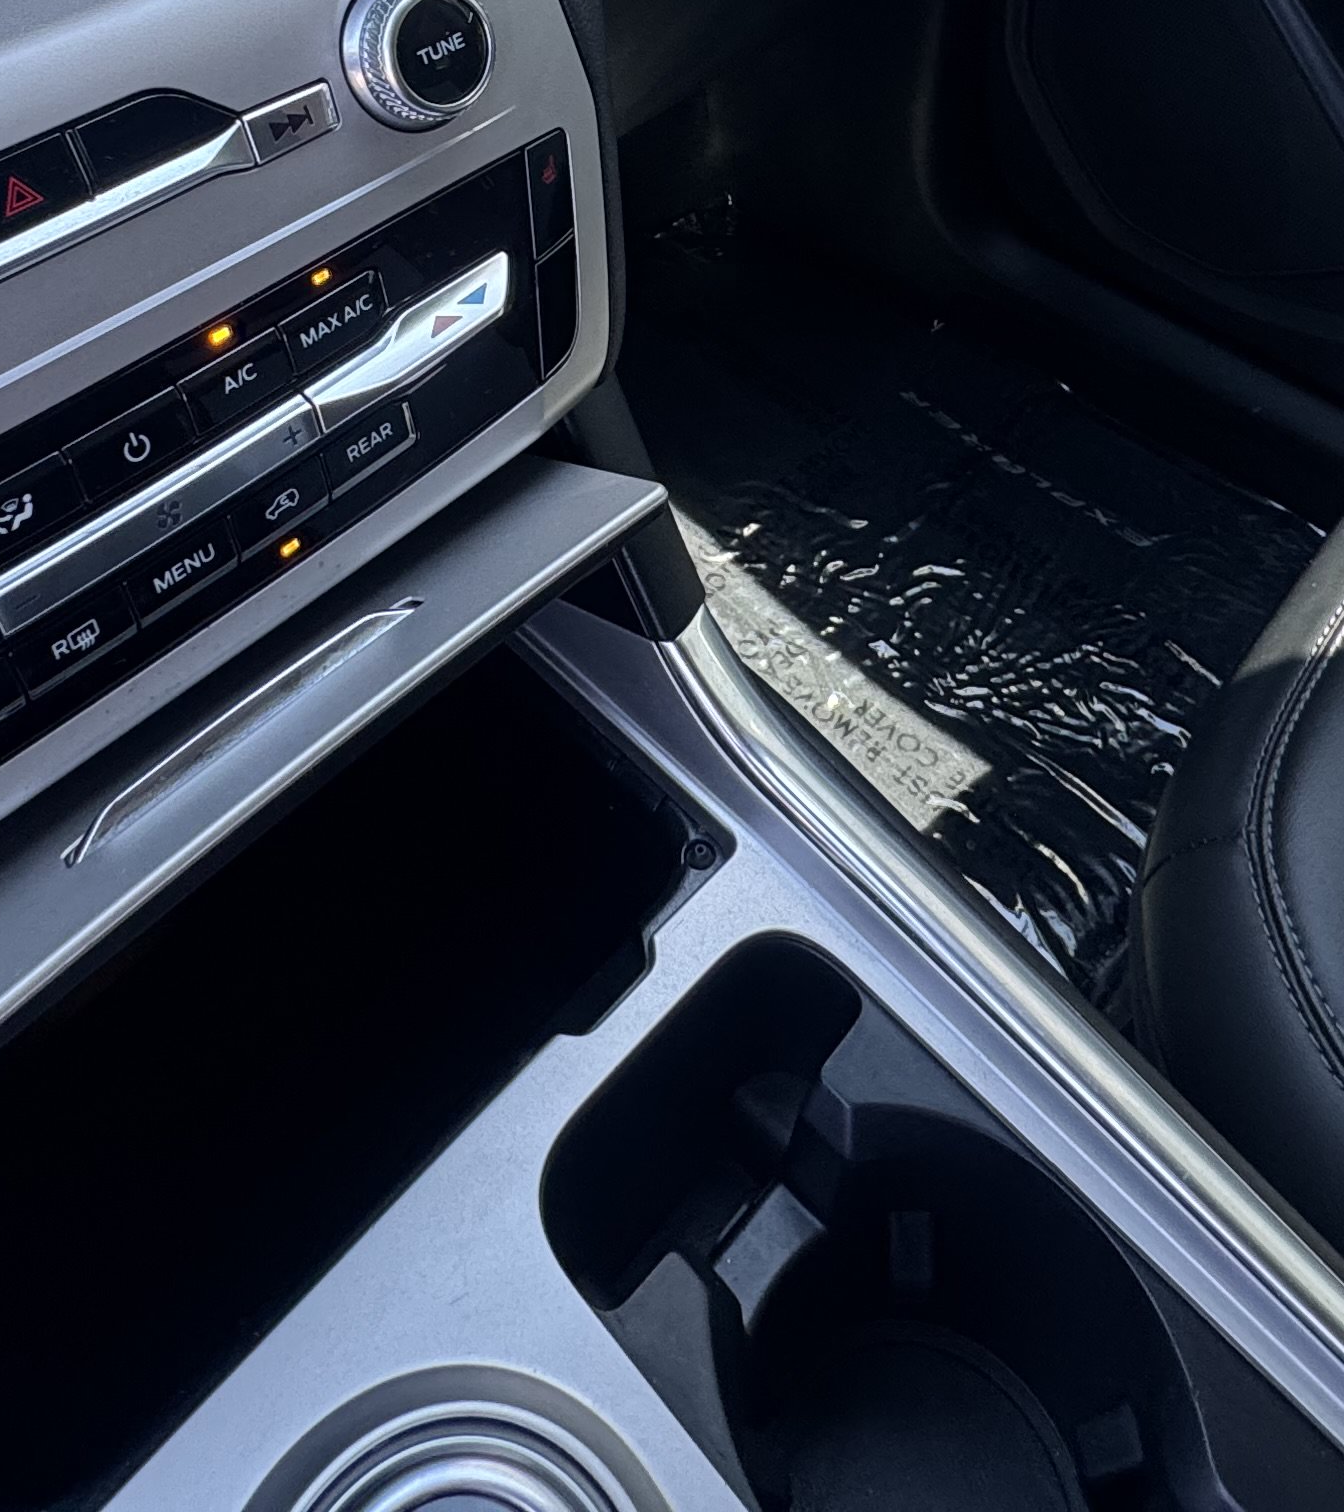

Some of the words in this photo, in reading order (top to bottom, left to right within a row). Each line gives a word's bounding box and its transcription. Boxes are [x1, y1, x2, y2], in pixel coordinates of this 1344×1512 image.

[416, 32, 466, 65] TUNE
[299, 315, 343, 348] MAX
[343, 294, 373, 323] A/C
[223, 362, 258, 394] A/C
[346, 422, 394, 463] REAR
[153, 543, 216, 593] MENU
